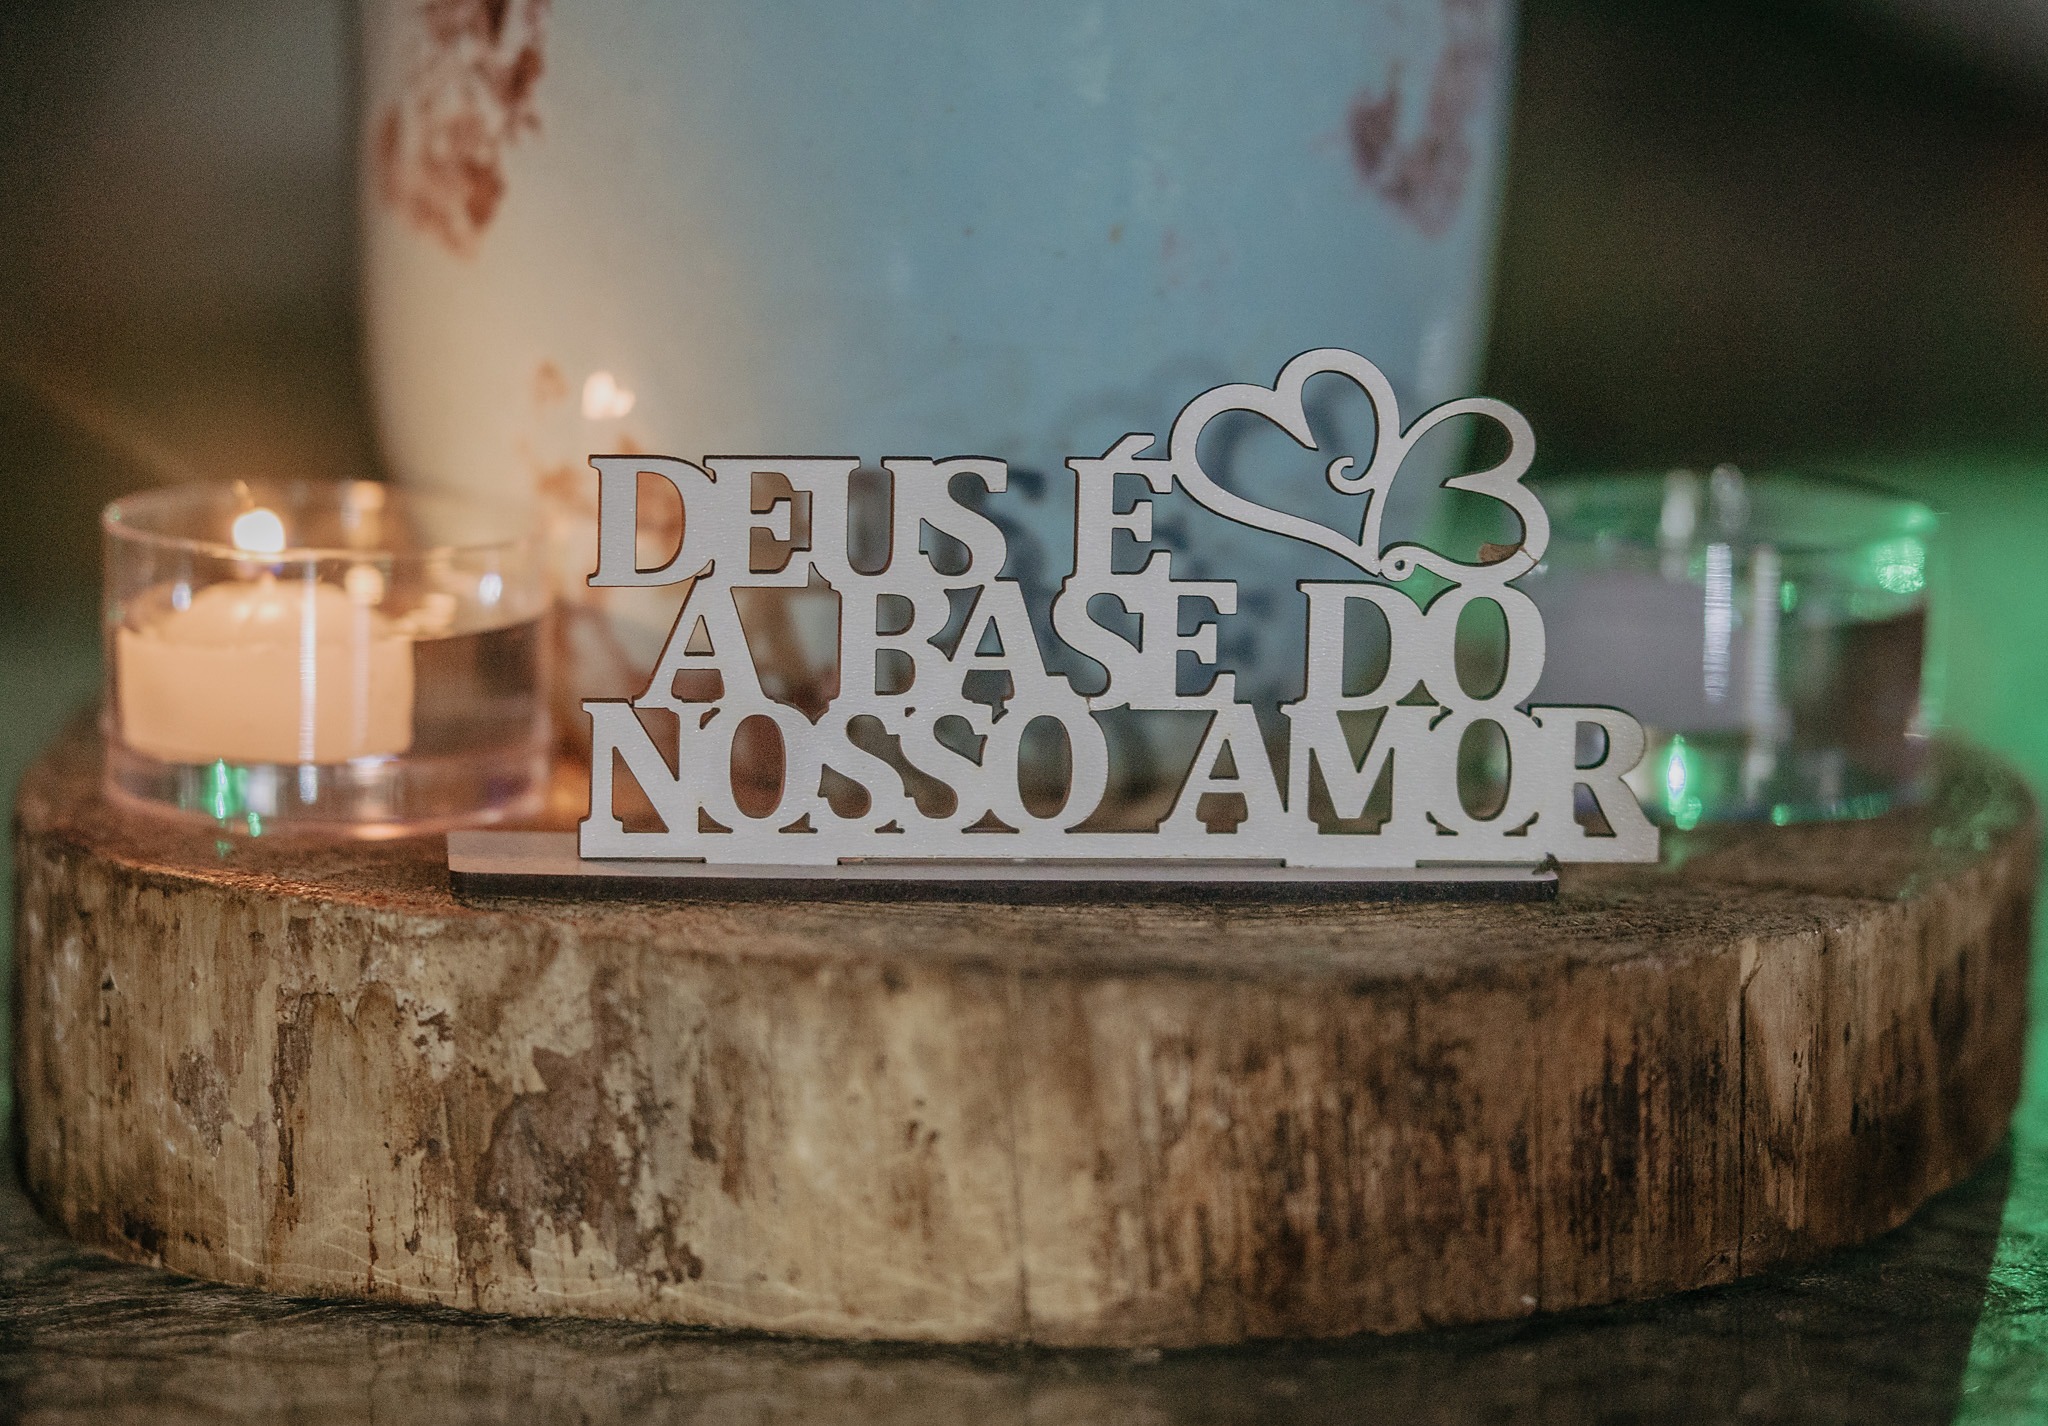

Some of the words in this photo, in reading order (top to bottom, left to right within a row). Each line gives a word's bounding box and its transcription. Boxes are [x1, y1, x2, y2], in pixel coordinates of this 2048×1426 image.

[588, 455, 1008, 589] DEUS
[1065, 432, 1174, 586] É
[632, 576, 776, 706] A
[827, 576, 1238, 710] BASE
[1296, 578, 1546, 710] DO
[580, 698, 1109, 842] NOSSO
[1156, 700, 1660, 846] AMOR
